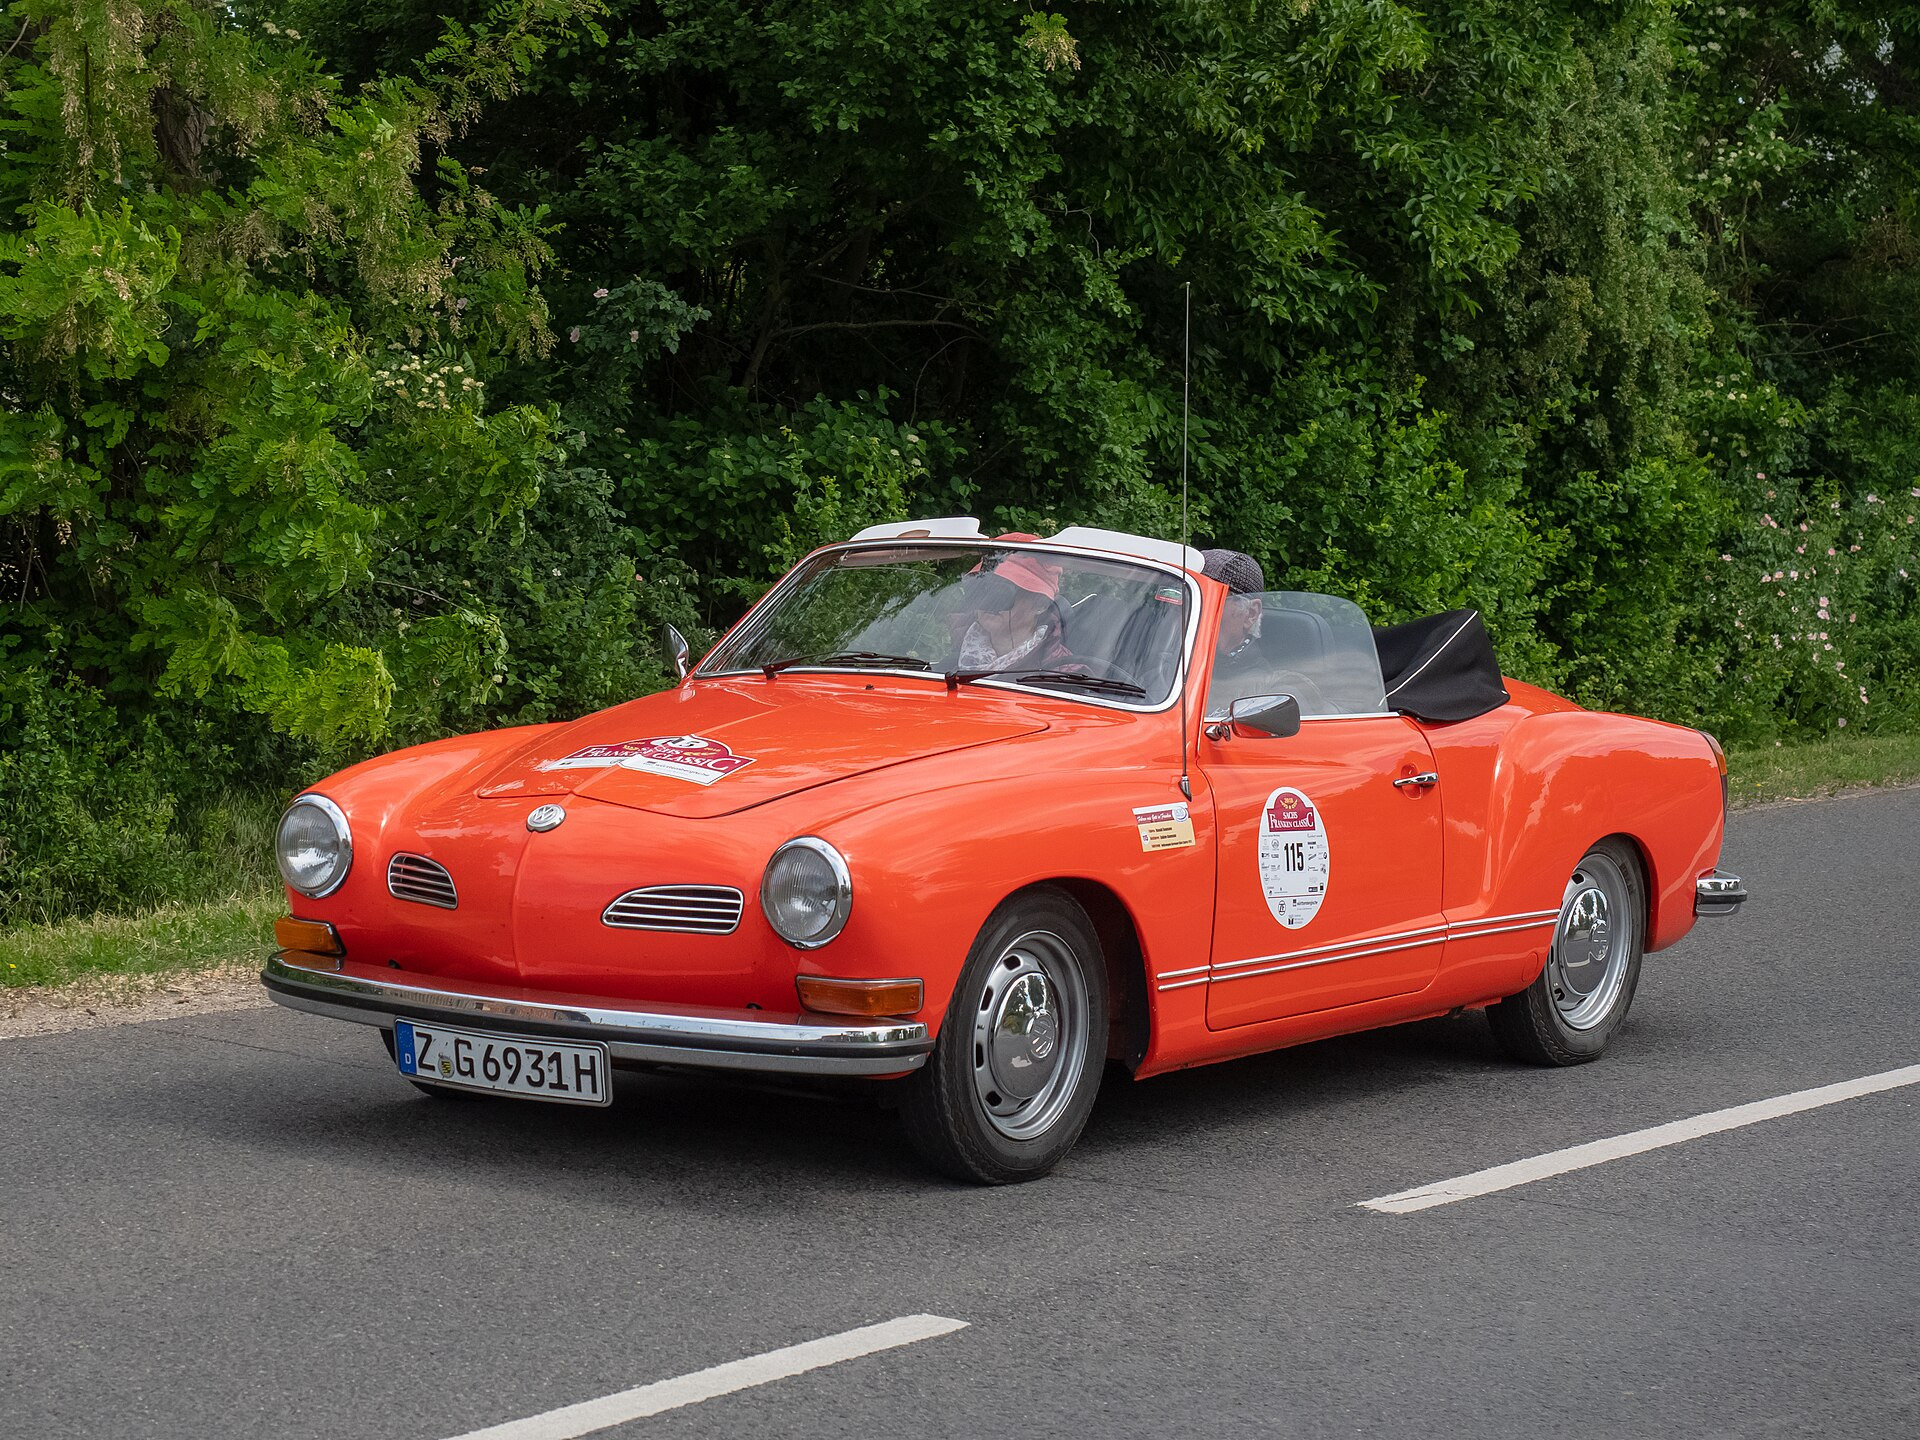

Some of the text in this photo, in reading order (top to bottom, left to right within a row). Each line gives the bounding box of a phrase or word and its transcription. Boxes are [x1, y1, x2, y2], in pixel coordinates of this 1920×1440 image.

[652, 753, 742, 771] CLASSIC
[1269, 813, 1293, 828] FRANKEN
[1282, 811, 1298, 819] SACHS
[1284, 842, 1304, 872] 115
[405, 1053, 412, 1065] D
[415, 1031, 436, 1072] Z
